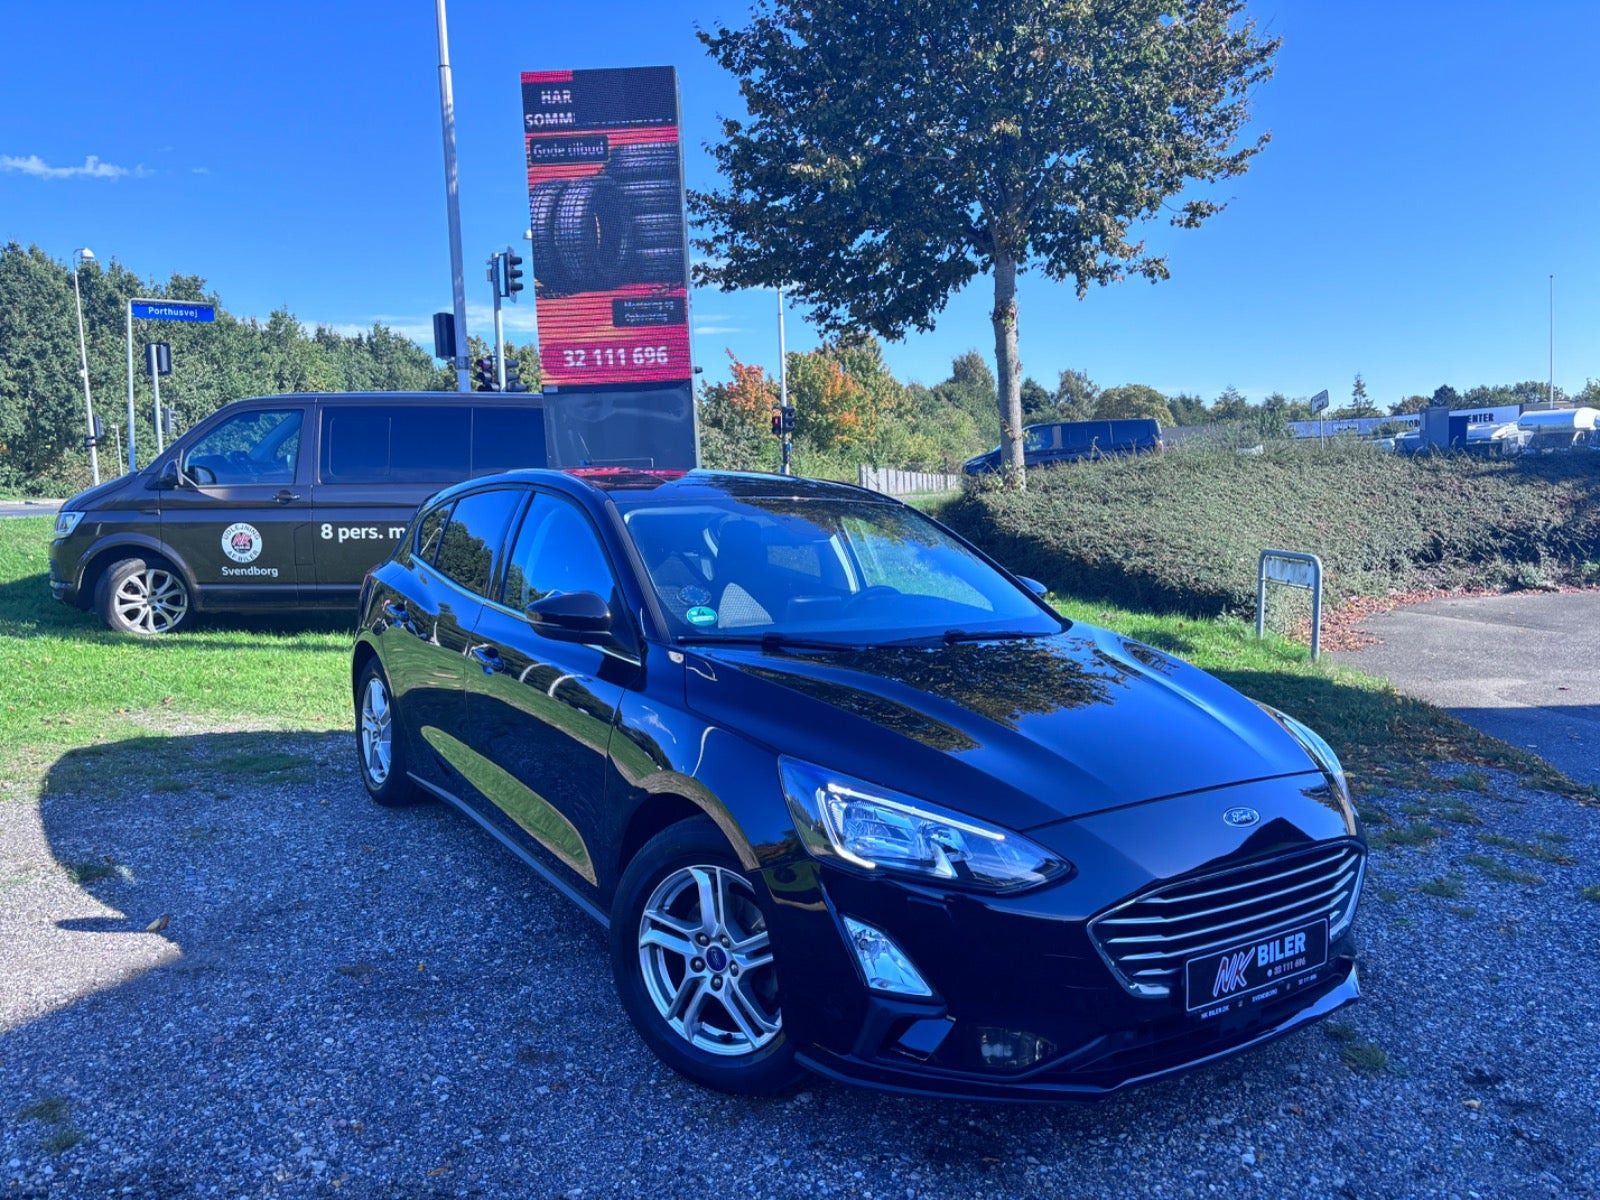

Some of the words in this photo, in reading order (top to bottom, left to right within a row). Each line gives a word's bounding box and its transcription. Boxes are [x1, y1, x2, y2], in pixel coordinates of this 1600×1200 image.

[541, 90, 572, 104] HAR
[525, 112, 575, 126] SOMM
[533, 143, 565, 158] Gode
[567, 141, 604, 156] tilbud
[148, 306, 198, 318] Porthusvej
[563, 350, 586, 367] 32
[593, 348, 626, 366] 111
[632, 346, 668, 365] 696
[320, 523, 333, 540] 8
[338, 527, 384, 543] pers.
[221, 566, 279, 578] Svendborg
[1212, 946, 1256, 998] NK
[1257, 932, 1306, 967] BILER
